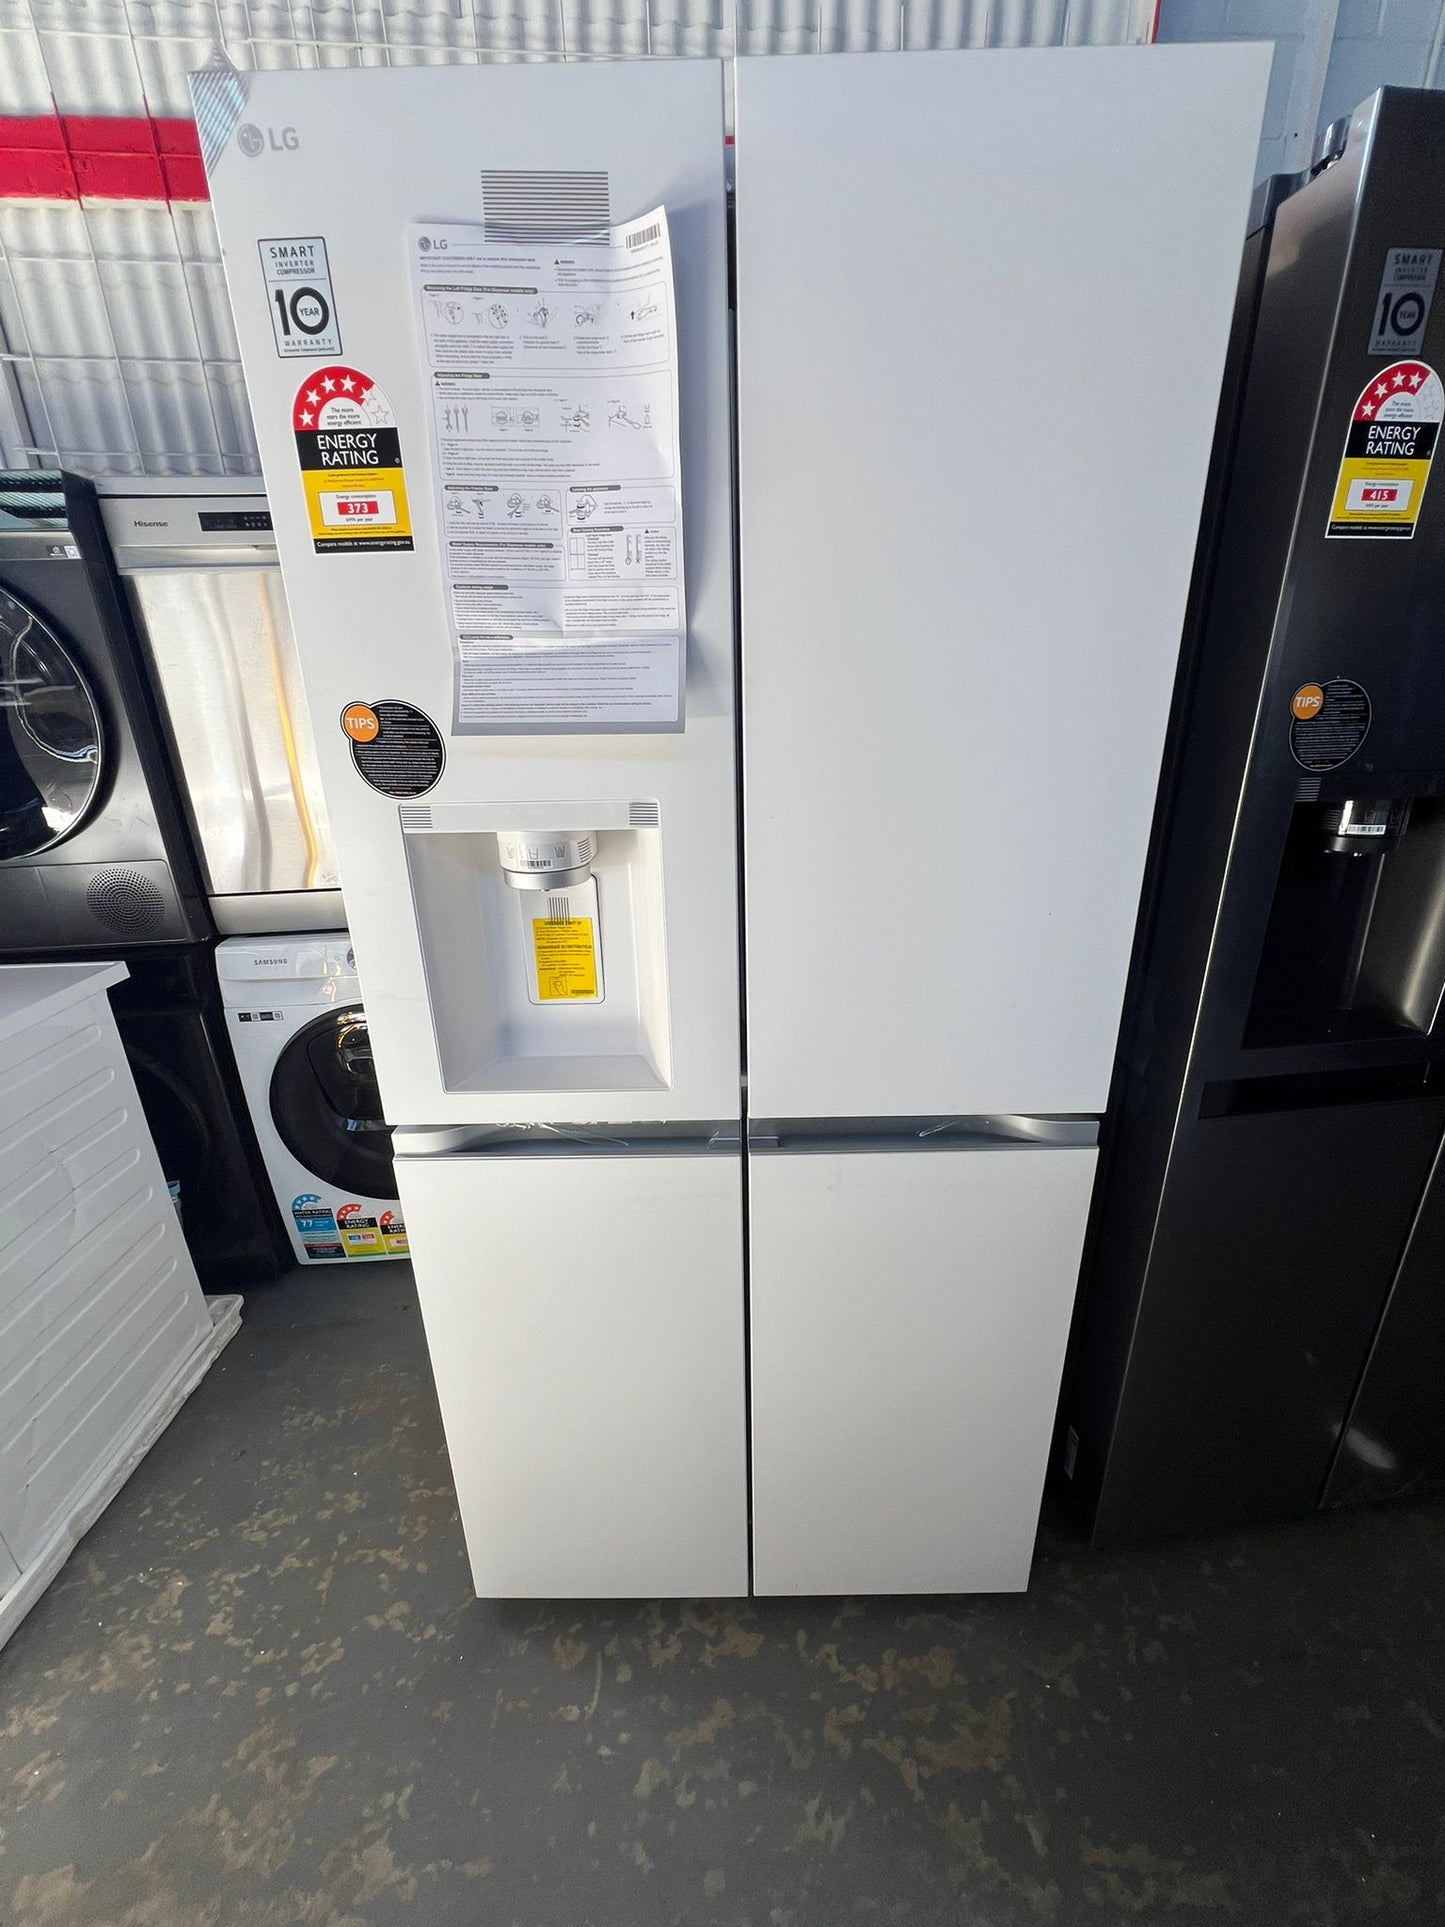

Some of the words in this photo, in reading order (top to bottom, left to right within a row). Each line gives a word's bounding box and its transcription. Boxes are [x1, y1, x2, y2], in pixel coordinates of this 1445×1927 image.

[268, 127, 299, 151] LG
[433, 239, 448, 250] LG
[270, 245, 314, 258] SMART
[1394, 254, 1433, 264] SMART
[275, 287, 329, 335] 10
[300, 308, 319, 316] YEAR
[1379, 292, 1425, 336] 10
[1368, 425, 1421, 440] ENERGY
[317, 433, 377, 449] ENERGY
[1365, 441, 1415, 455] RATING
[321, 450, 379, 466] RATING
[1369, 491, 1389, 500] 415
[347, 503, 369, 513] 373
[133, 520, 168, 528] Hisense
[1295, 697, 1321, 708] TIPS
[346, 717, 375, 730] TIPS
[254, 958, 287, 966] SAMSUNG
